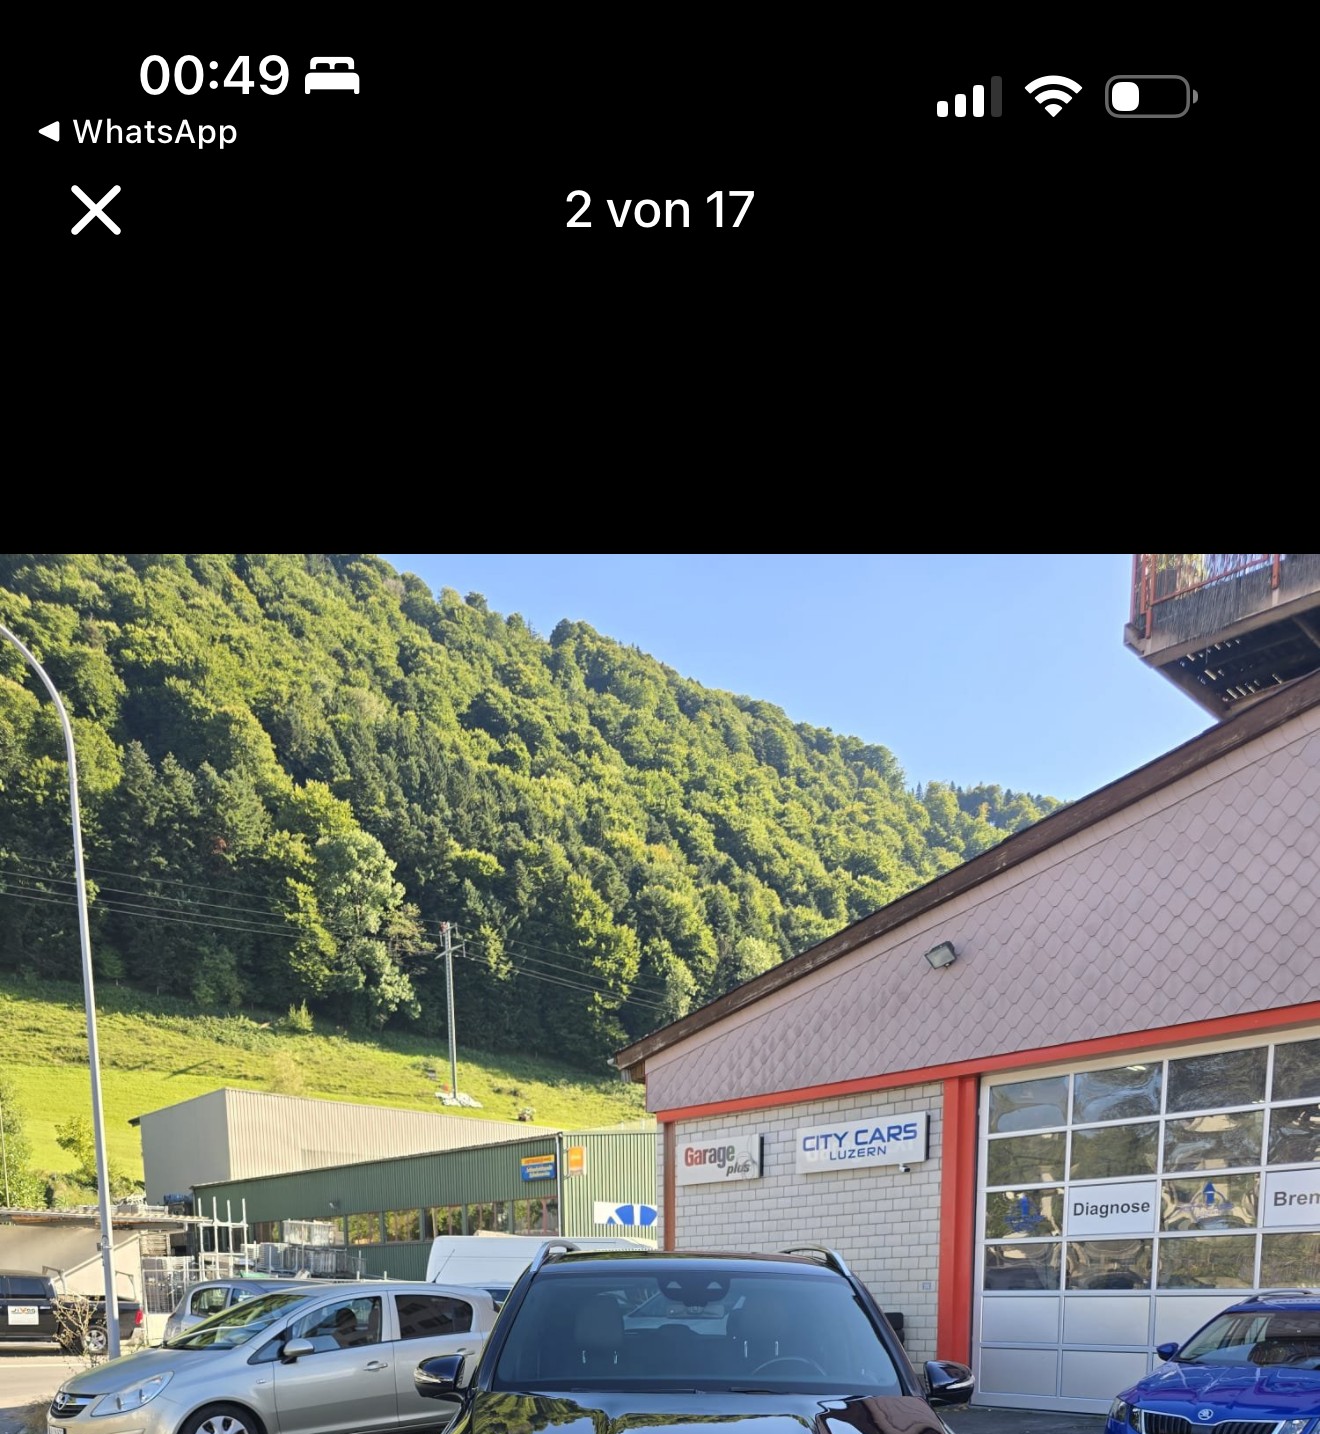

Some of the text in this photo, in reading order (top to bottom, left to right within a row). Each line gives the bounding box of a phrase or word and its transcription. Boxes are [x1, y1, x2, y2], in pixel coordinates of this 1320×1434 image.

[802, 1122, 918, 1152] CITY CARS
[684, 1145, 735, 1168] Garage
[829, 1146, 887, 1161] LUZERN
[726, 1161, 750, 1177] plus
[1073, 1202, 1150, 1218] Diagnose
